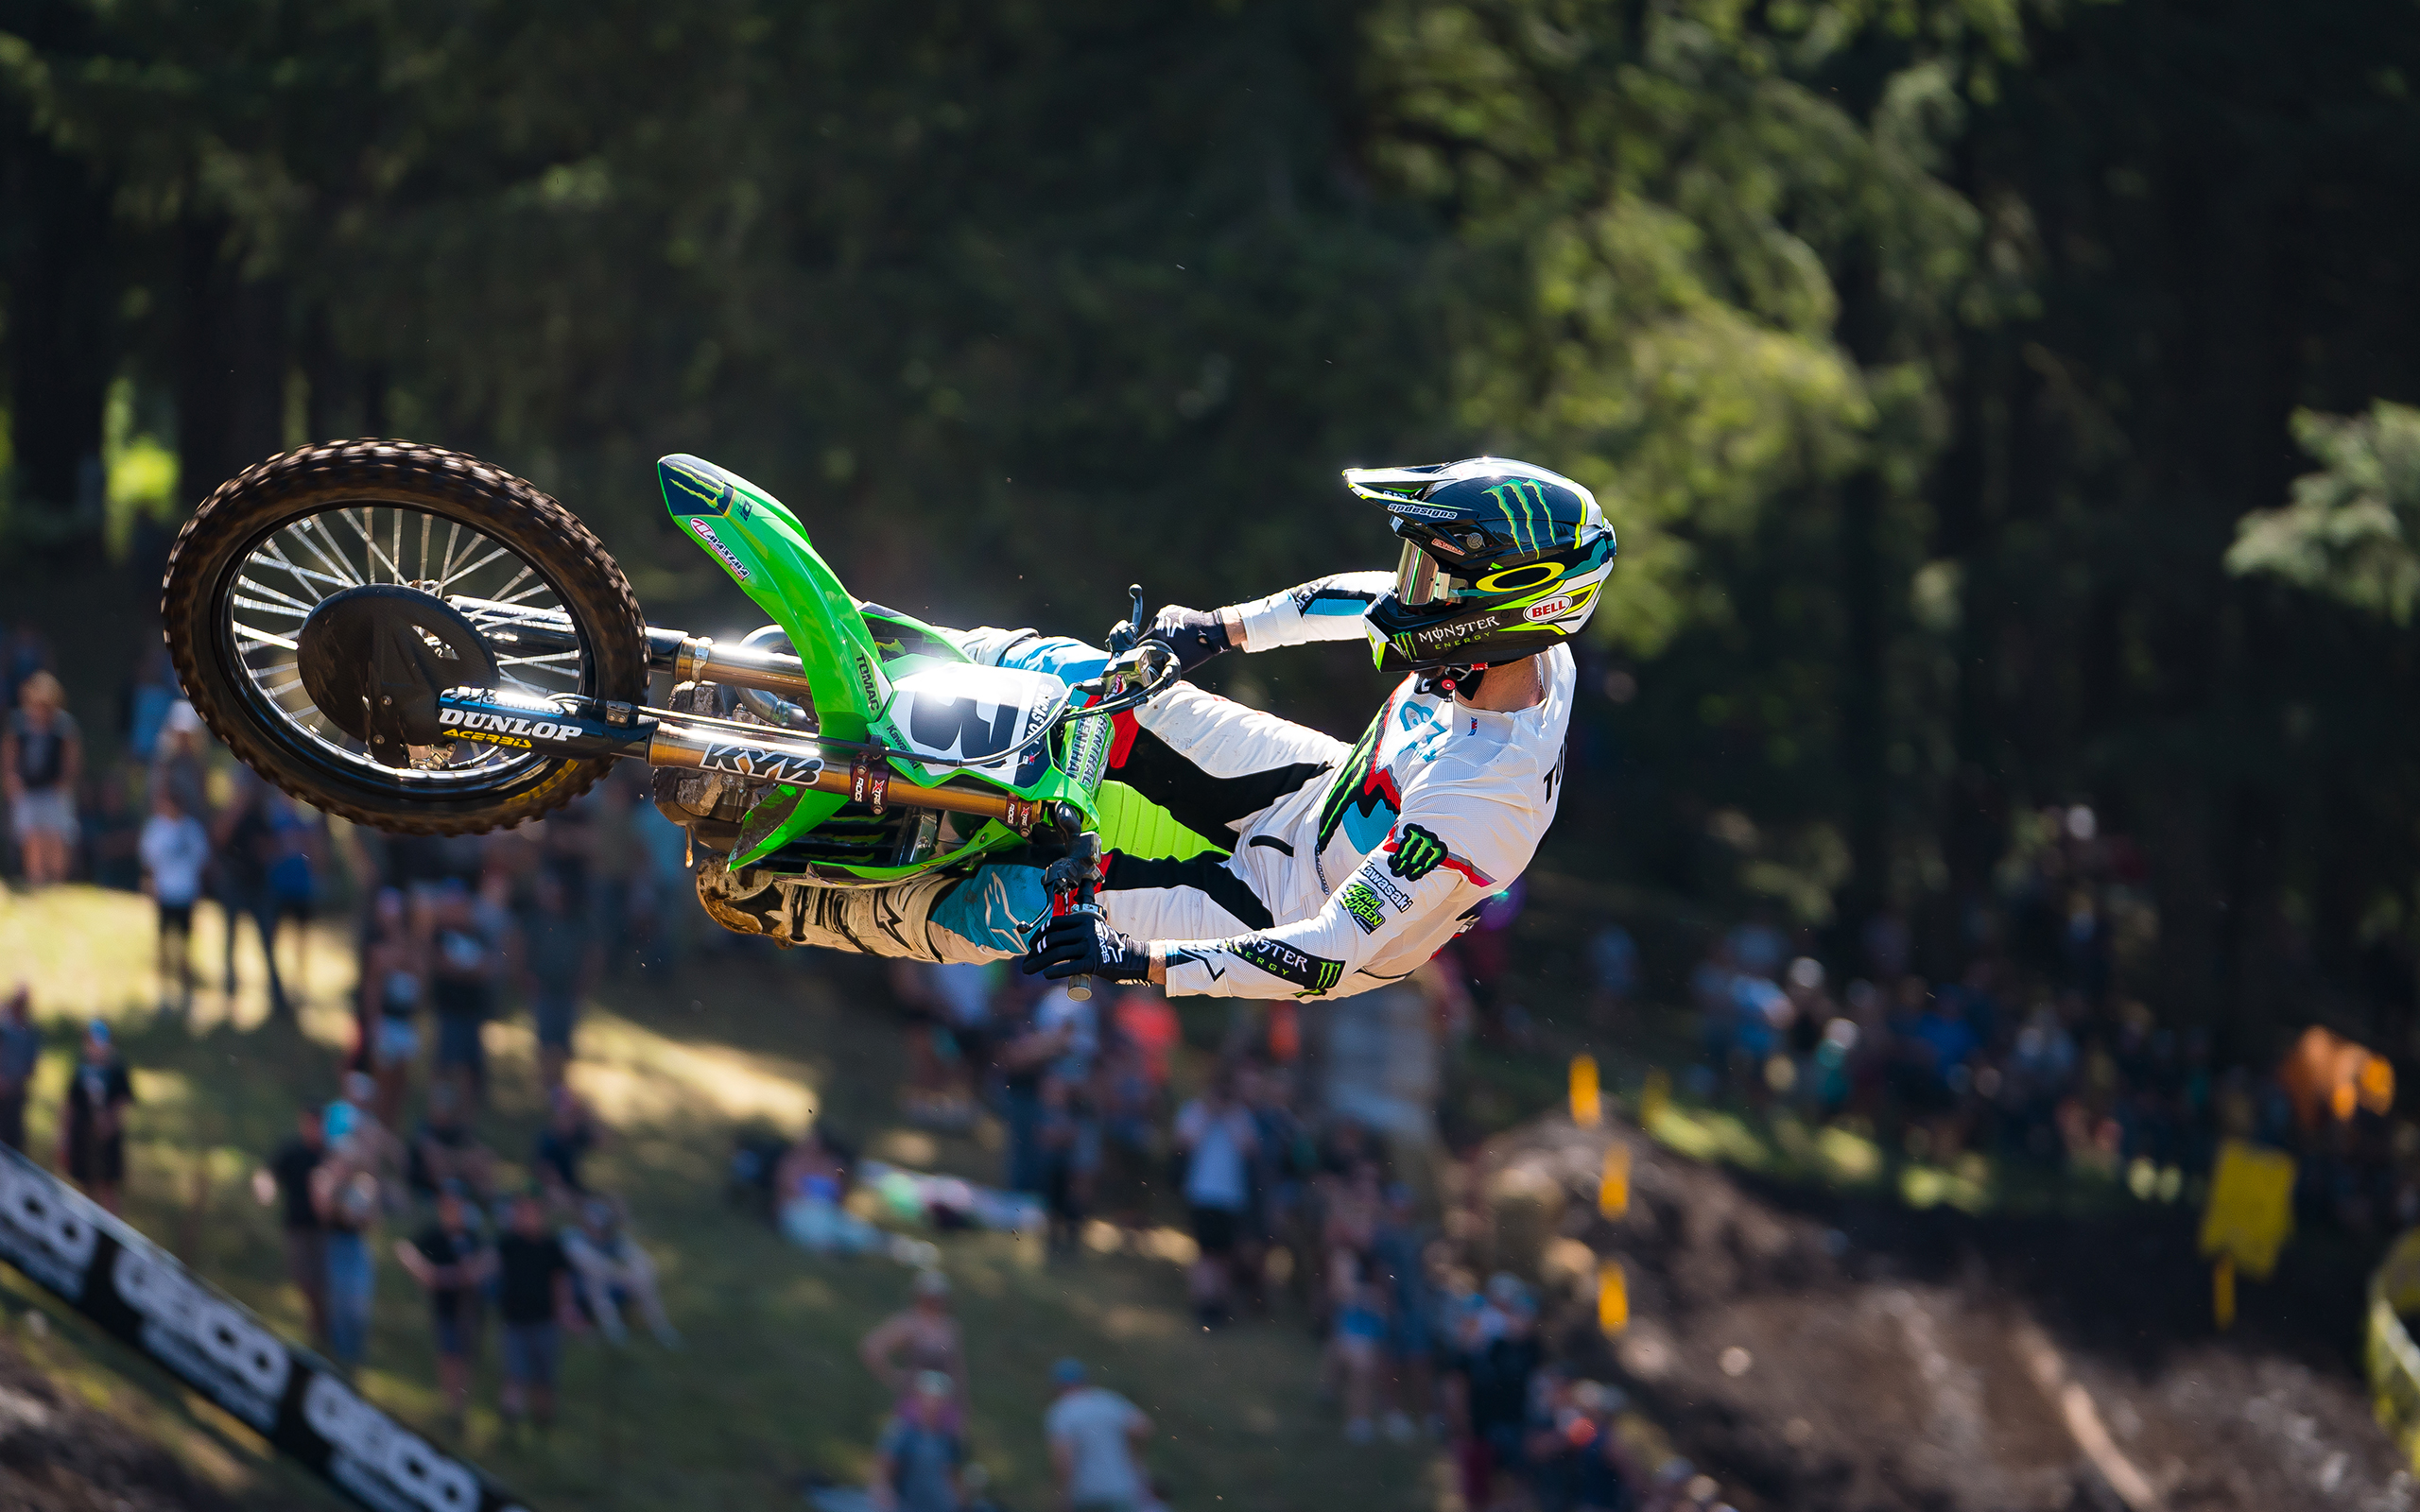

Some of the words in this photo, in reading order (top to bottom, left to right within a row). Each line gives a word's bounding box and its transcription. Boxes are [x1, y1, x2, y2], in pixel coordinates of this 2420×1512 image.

[1531, 600, 1566, 618] BELL
[1418, 615, 1500, 644] MONSTER
[1434, 630, 1492, 650] ENERGY
[856, 652, 880, 712] TOMAC
[439, 708, 583, 742] DUNLOP
[886, 724, 922, 770] Kawaki
[1081, 715, 1109, 788] RENTHAL
[699, 741, 825, 786] KYB
[855, 776, 865, 802] ROCS
[1342, 895, 1383, 926] GREEN
[1346, 881, 1382, 910] TEAM
[1230, 944, 1289, 976] ERGY
[1233, 934, 1307, 972] NSTER
